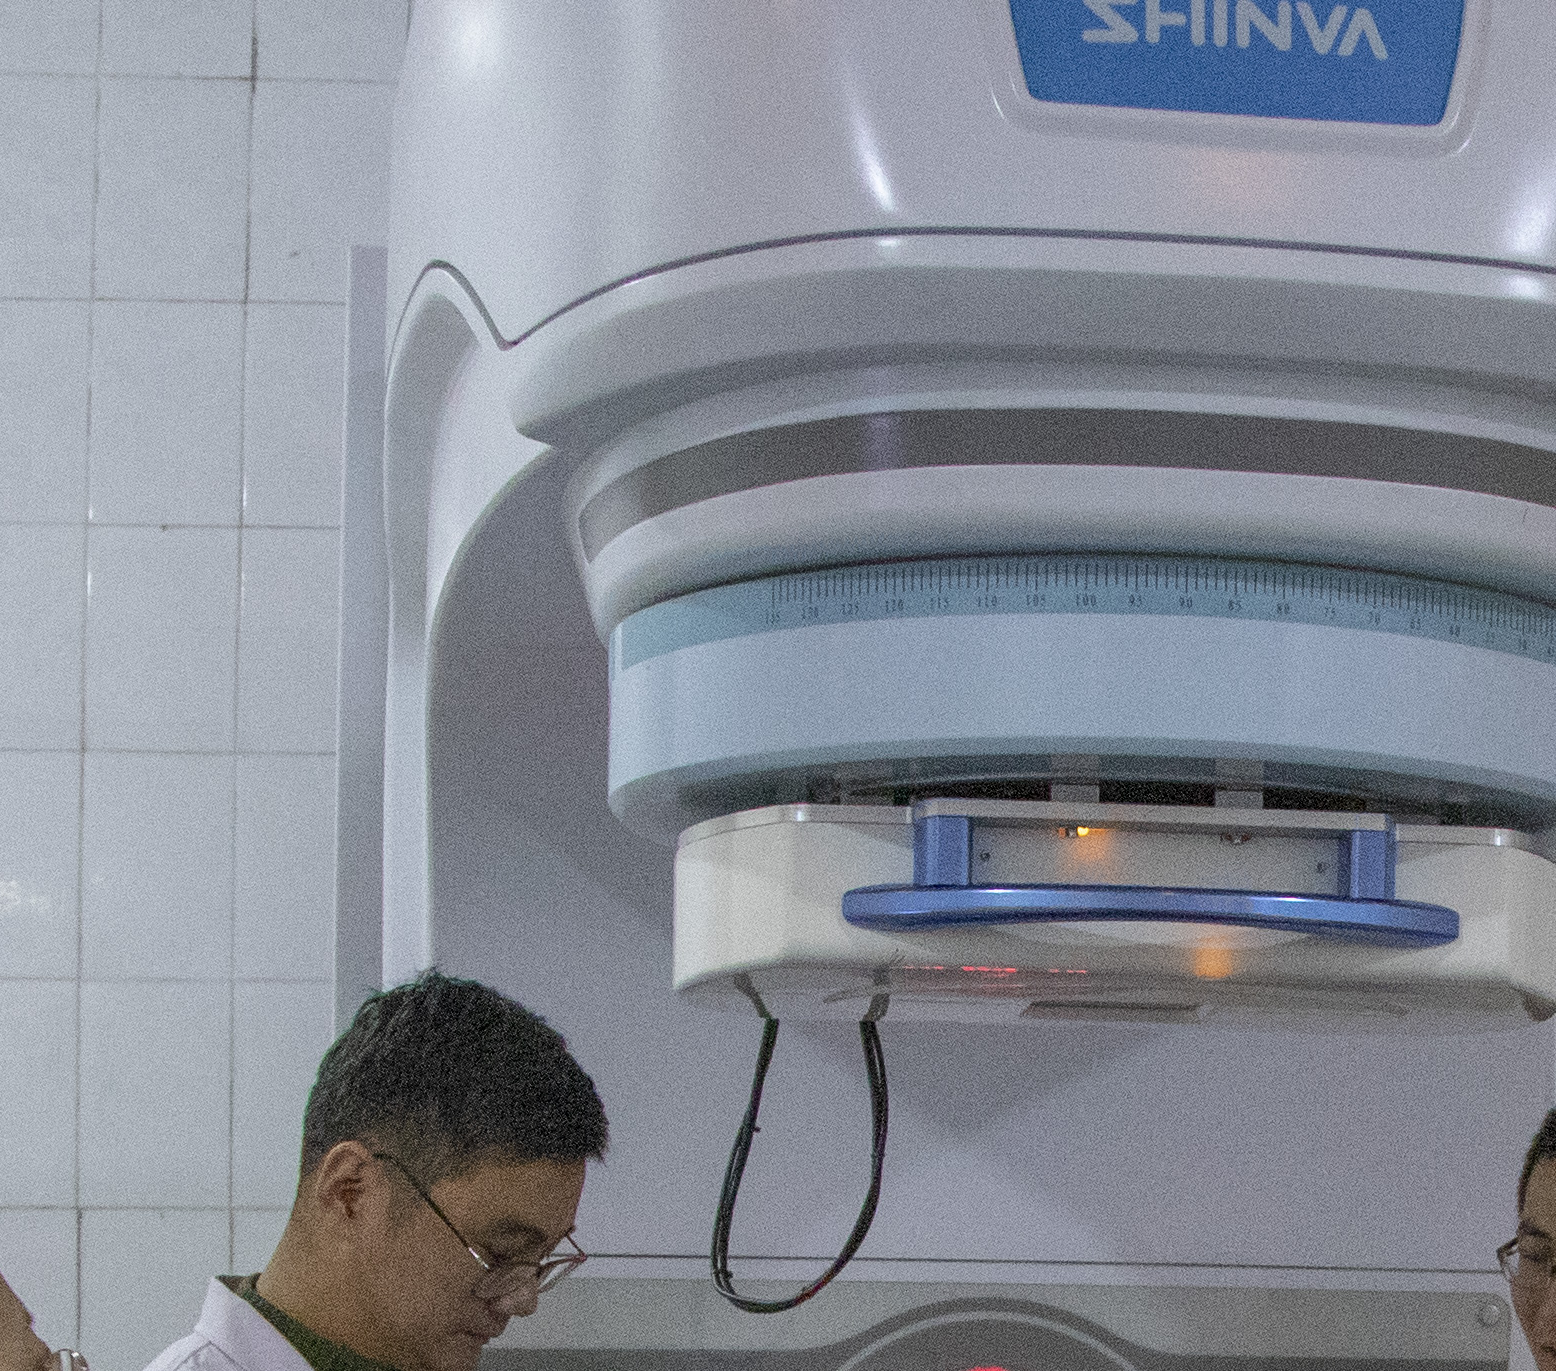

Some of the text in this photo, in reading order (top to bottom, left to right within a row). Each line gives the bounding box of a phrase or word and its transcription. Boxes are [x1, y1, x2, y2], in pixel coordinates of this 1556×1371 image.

[1081, 0, 1389, 61] SHINVA
[885, 598, 904, 613] 120
[930, 596, 950, 610] 115
[977, 595, 998, 608] 110
[1026, 594, 1046, 607] 105
[1076, 594, 1097, 607] 100
[1128, 594, 1143, 608] 95
[1179, 596, 1193, 609] 90
